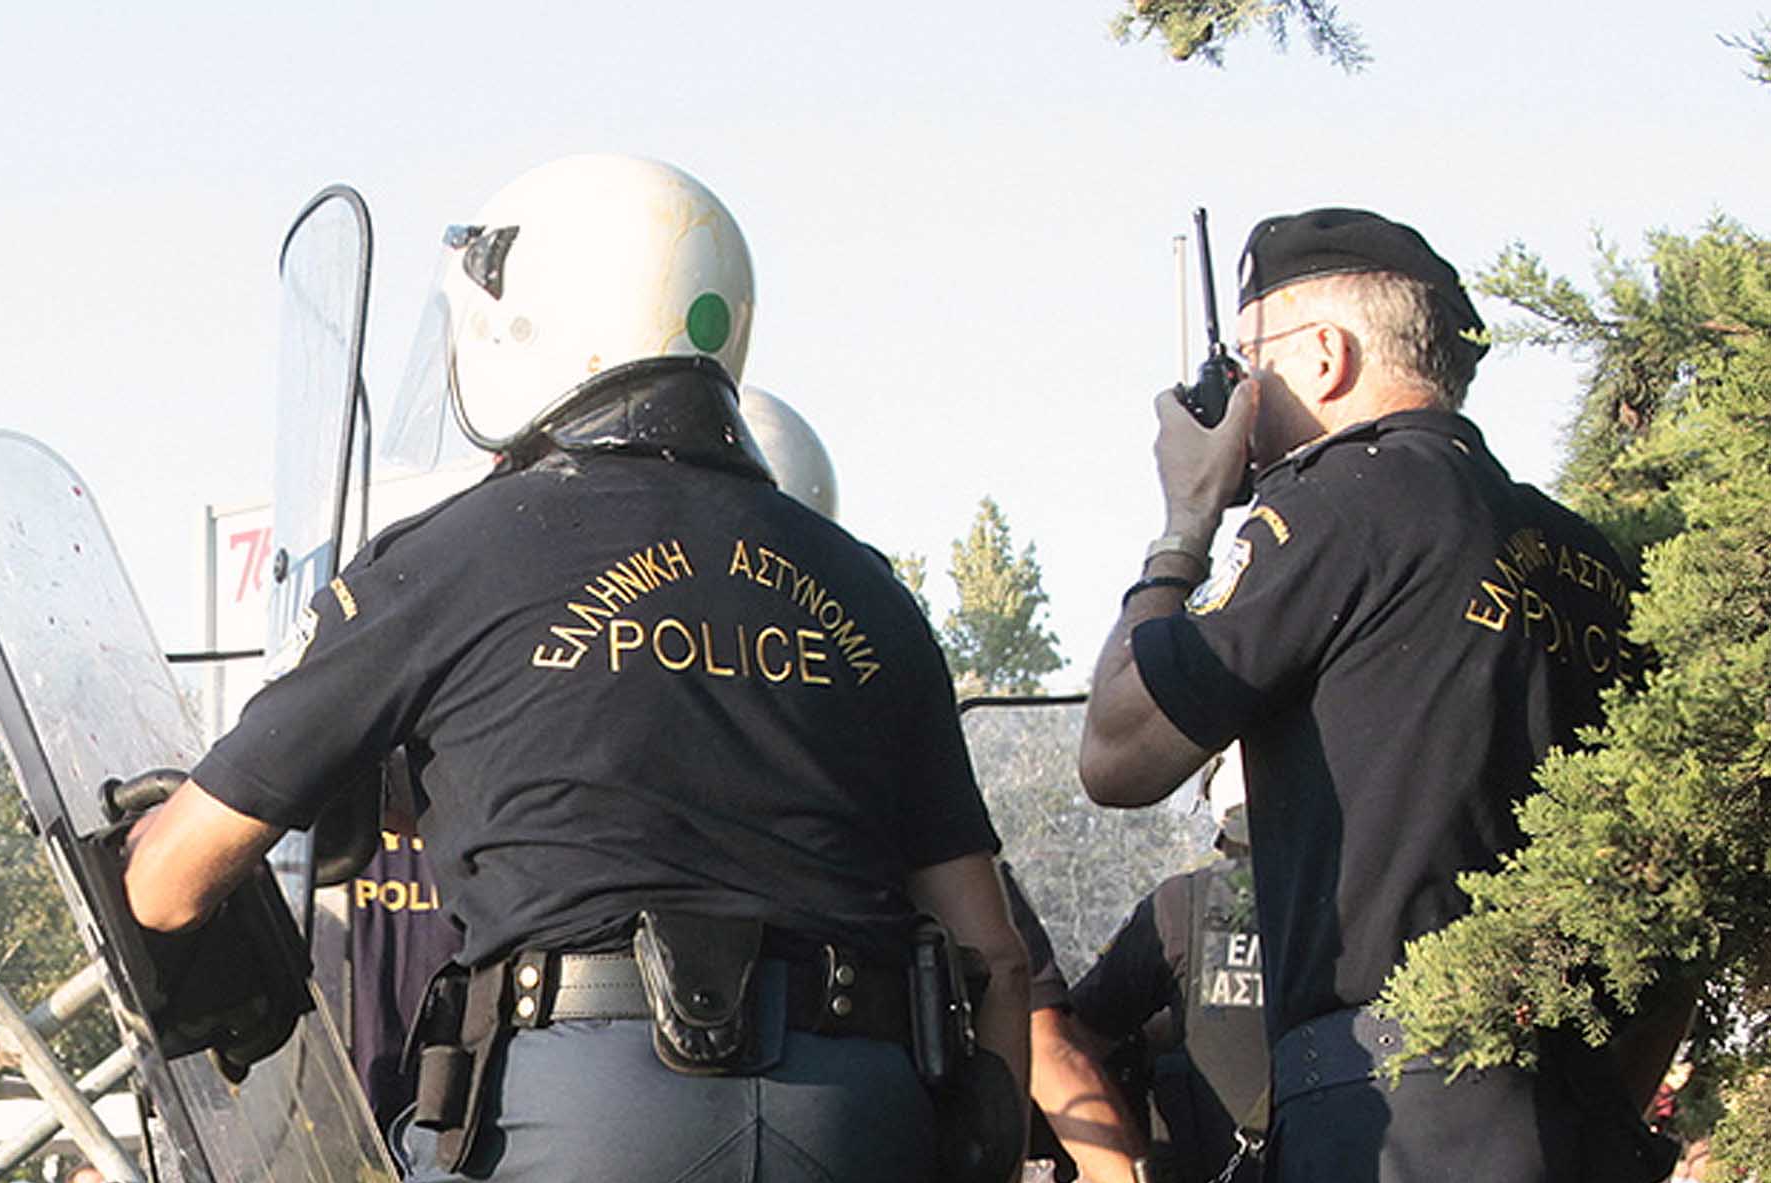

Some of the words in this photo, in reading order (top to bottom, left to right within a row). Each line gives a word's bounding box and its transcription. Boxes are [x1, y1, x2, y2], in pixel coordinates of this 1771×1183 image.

[531, 539, 694, 670] ΕΛΛΗΝΙΚΗ
[729, 539, 881, 686] ΑΣΤΥΝΟΜΙΑ
[608, 617, 832, 685] POLICE
